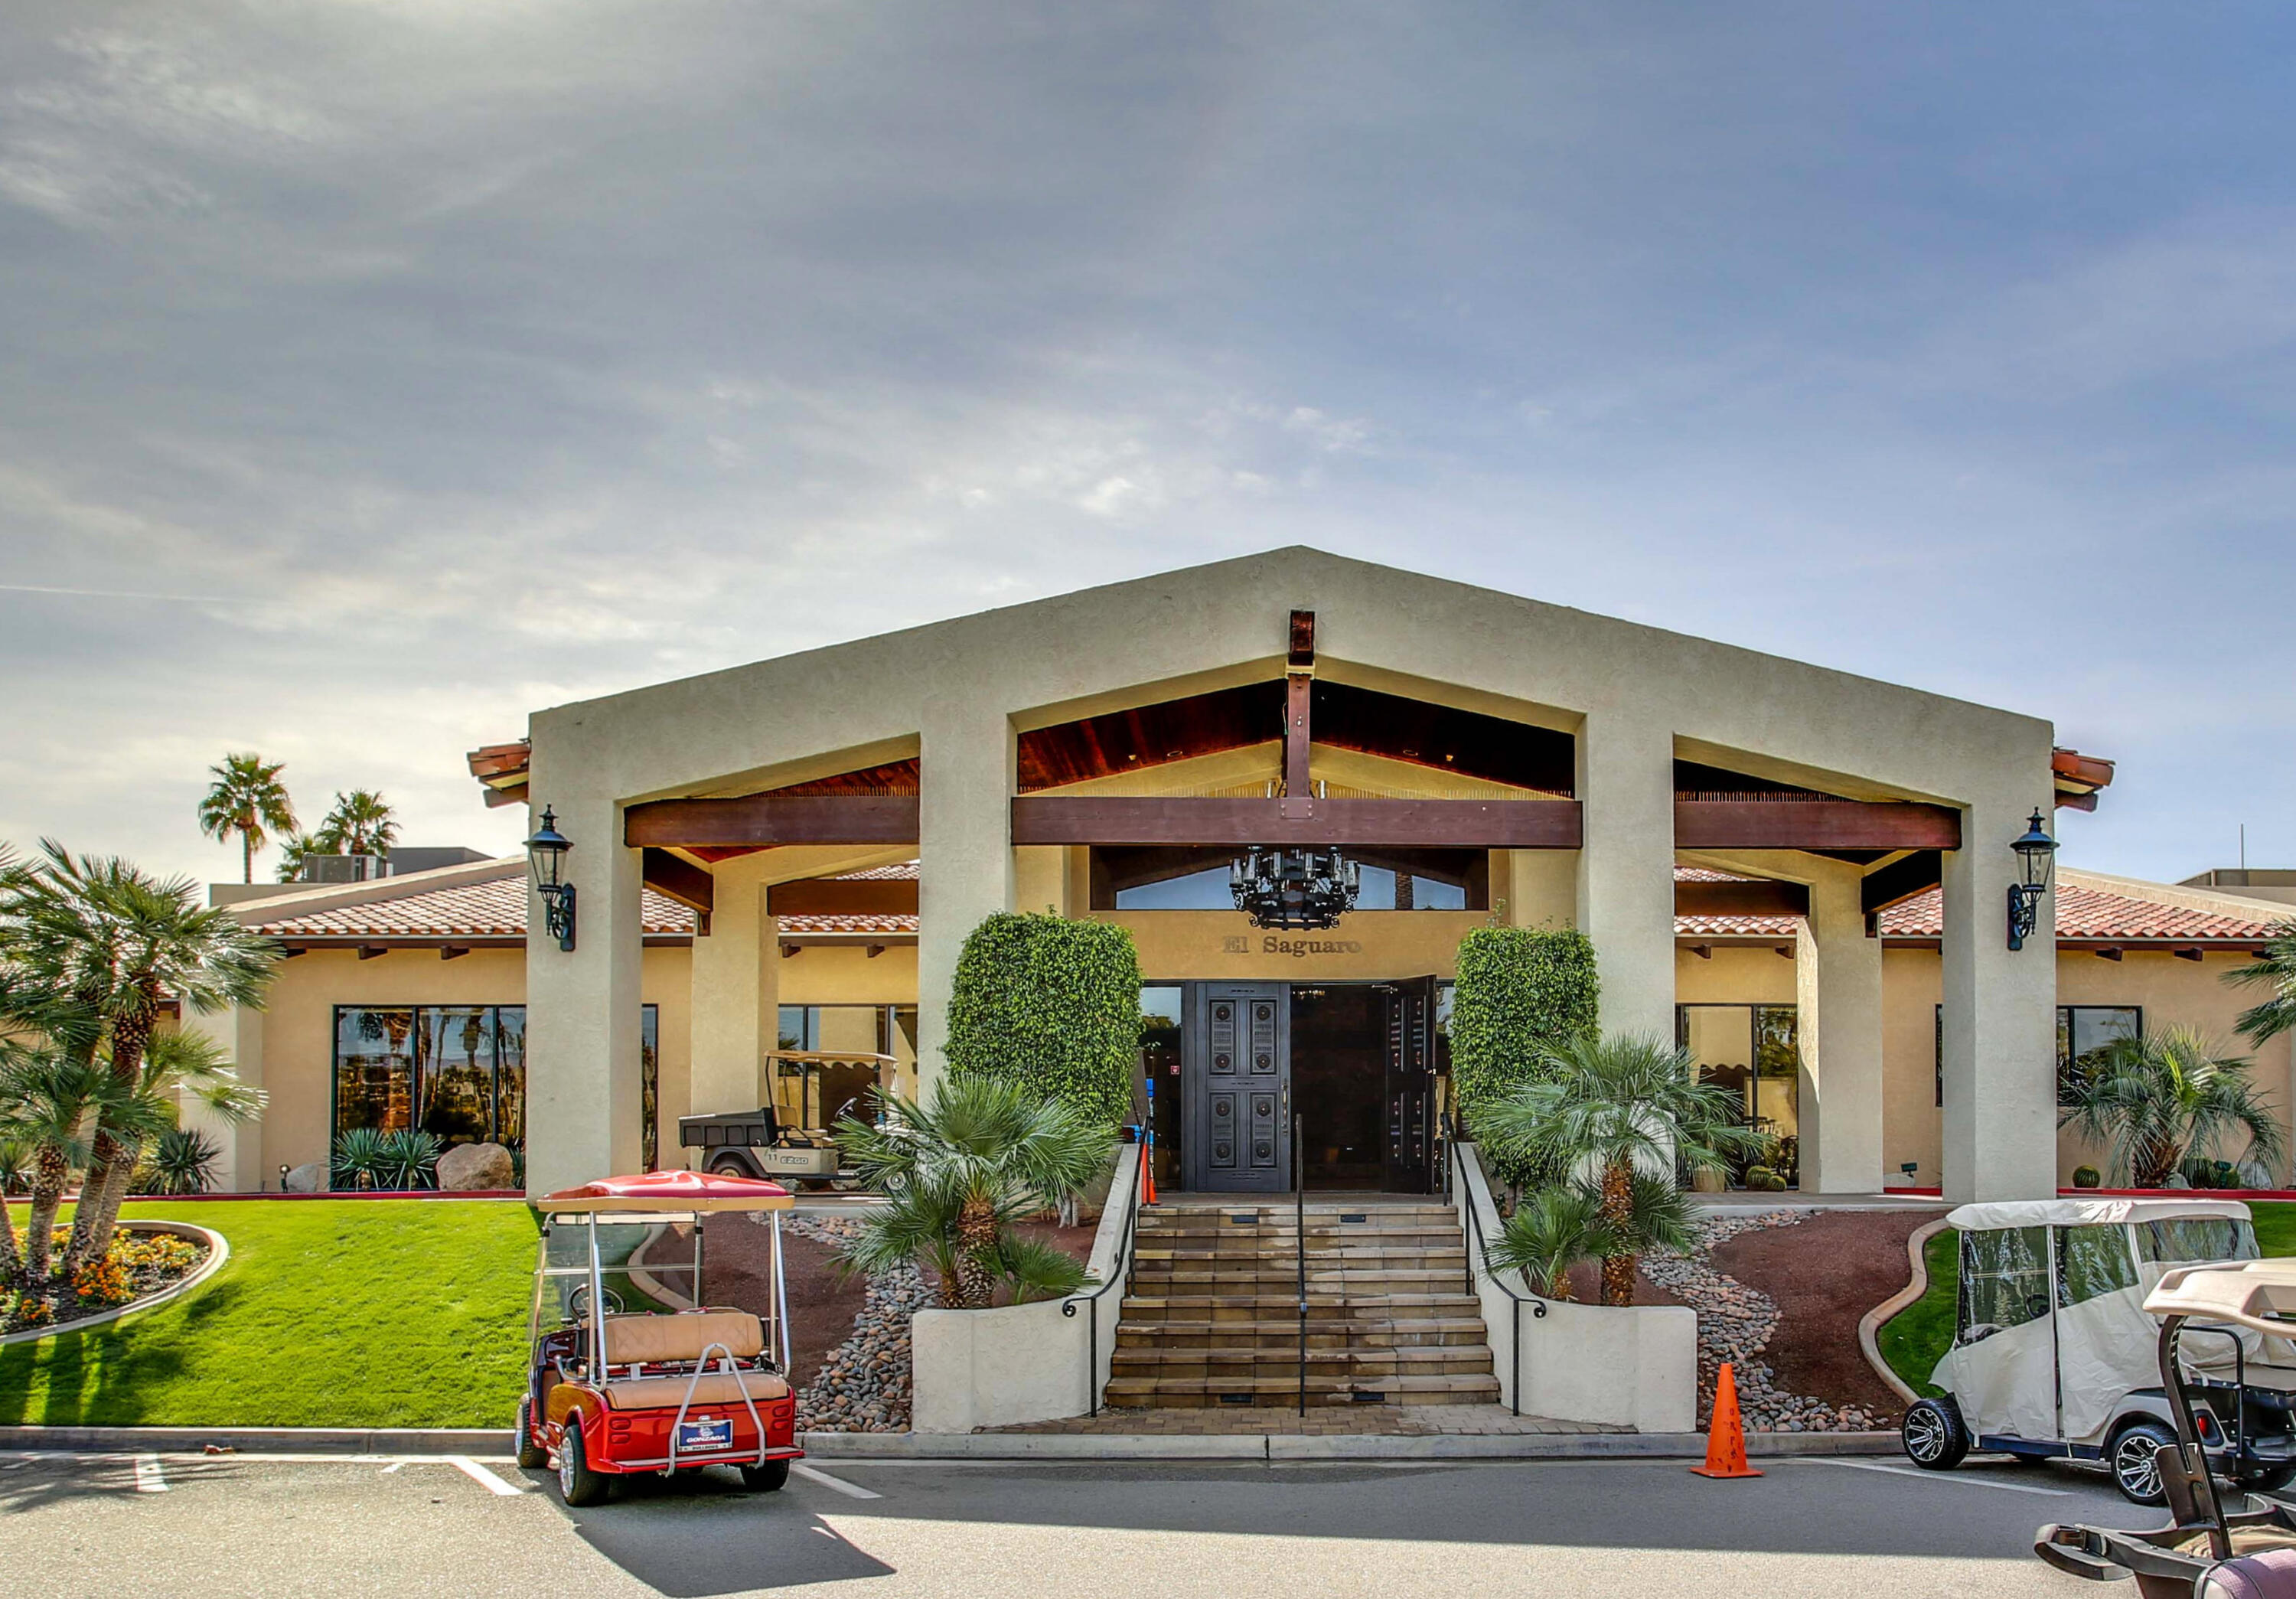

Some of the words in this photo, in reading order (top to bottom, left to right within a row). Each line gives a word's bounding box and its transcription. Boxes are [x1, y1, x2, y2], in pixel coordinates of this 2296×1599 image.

[1224, 935, 1249, 954] El
[1263, 935, 1362, 958] Saguaro
[686, 1434, 726, 1444] GONZAGA
